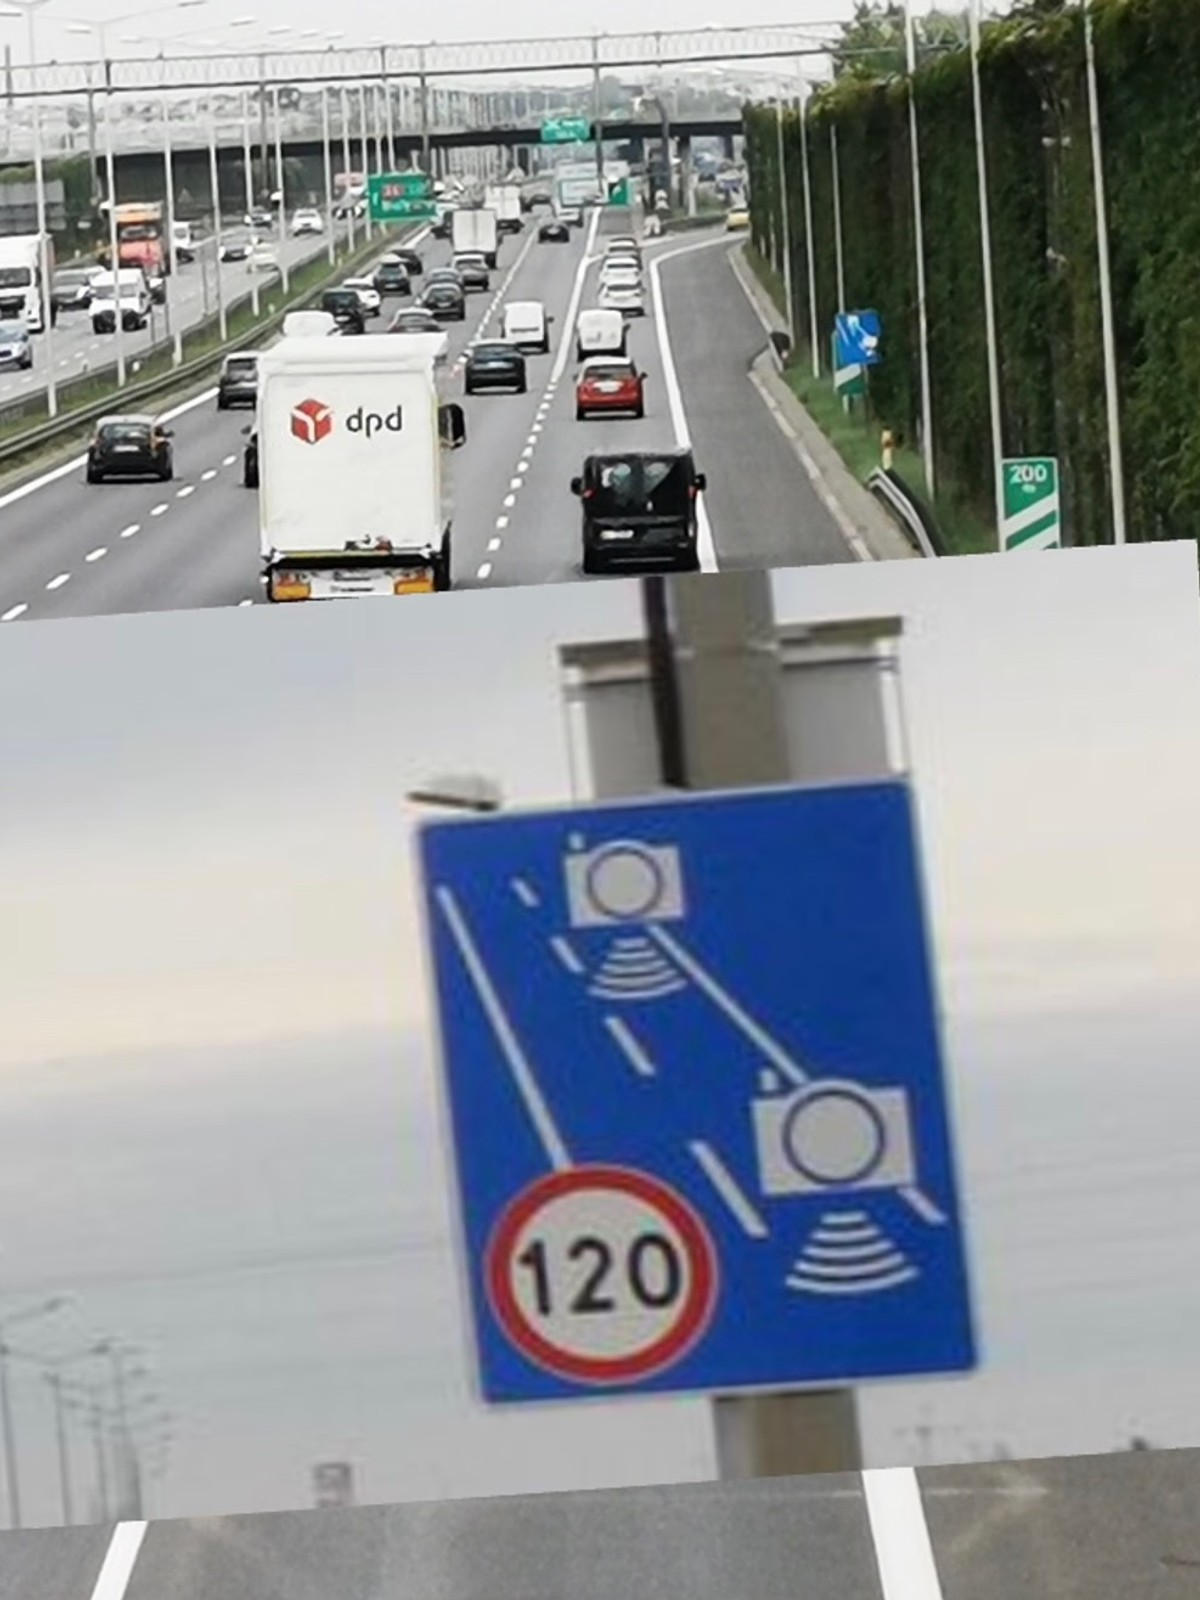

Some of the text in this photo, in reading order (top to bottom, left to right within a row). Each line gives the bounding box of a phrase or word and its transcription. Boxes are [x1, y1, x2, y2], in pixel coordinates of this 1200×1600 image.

[345, 404, 403, 439] dpd
[1009, 464, 1047, 485] 200
[518, 1233, 681, 1316] 120
